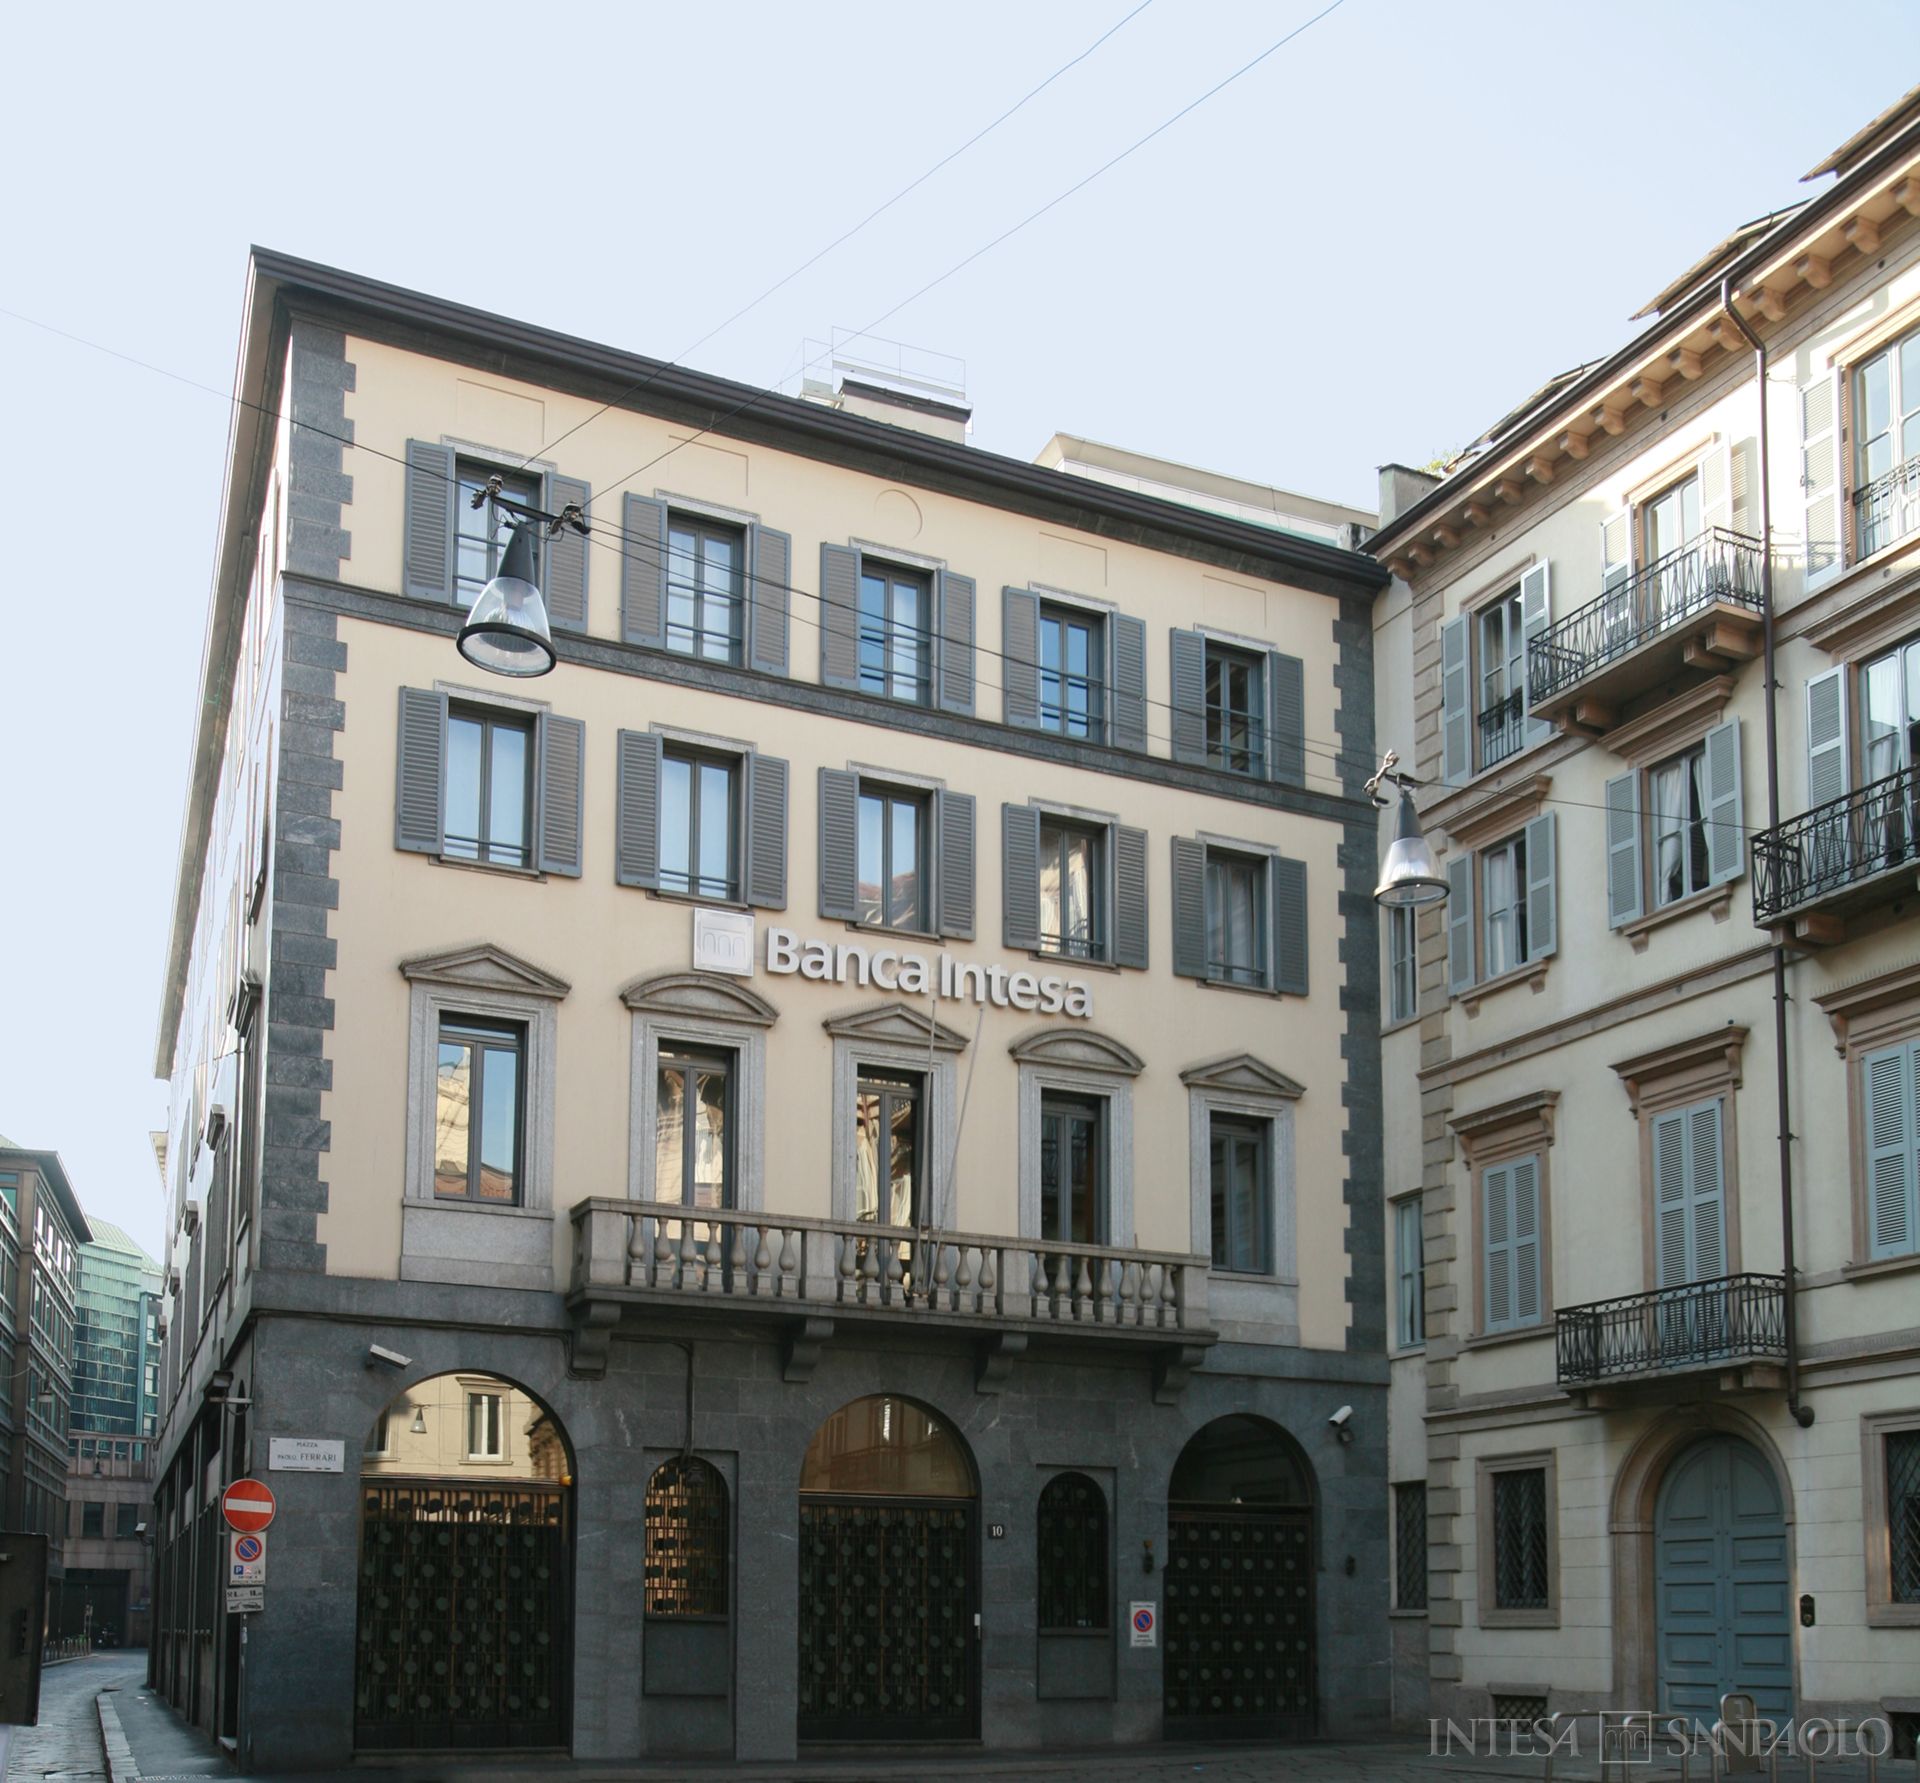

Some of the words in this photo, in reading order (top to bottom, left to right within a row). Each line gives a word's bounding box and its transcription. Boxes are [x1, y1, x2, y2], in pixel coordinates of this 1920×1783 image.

[767, 927, 929, 994] Banca
[940, 953, 1093, 1019] Intesa
[300, 1453, 336, 1462] FERRARI
[993, 1525, 1003, 1537] 10
